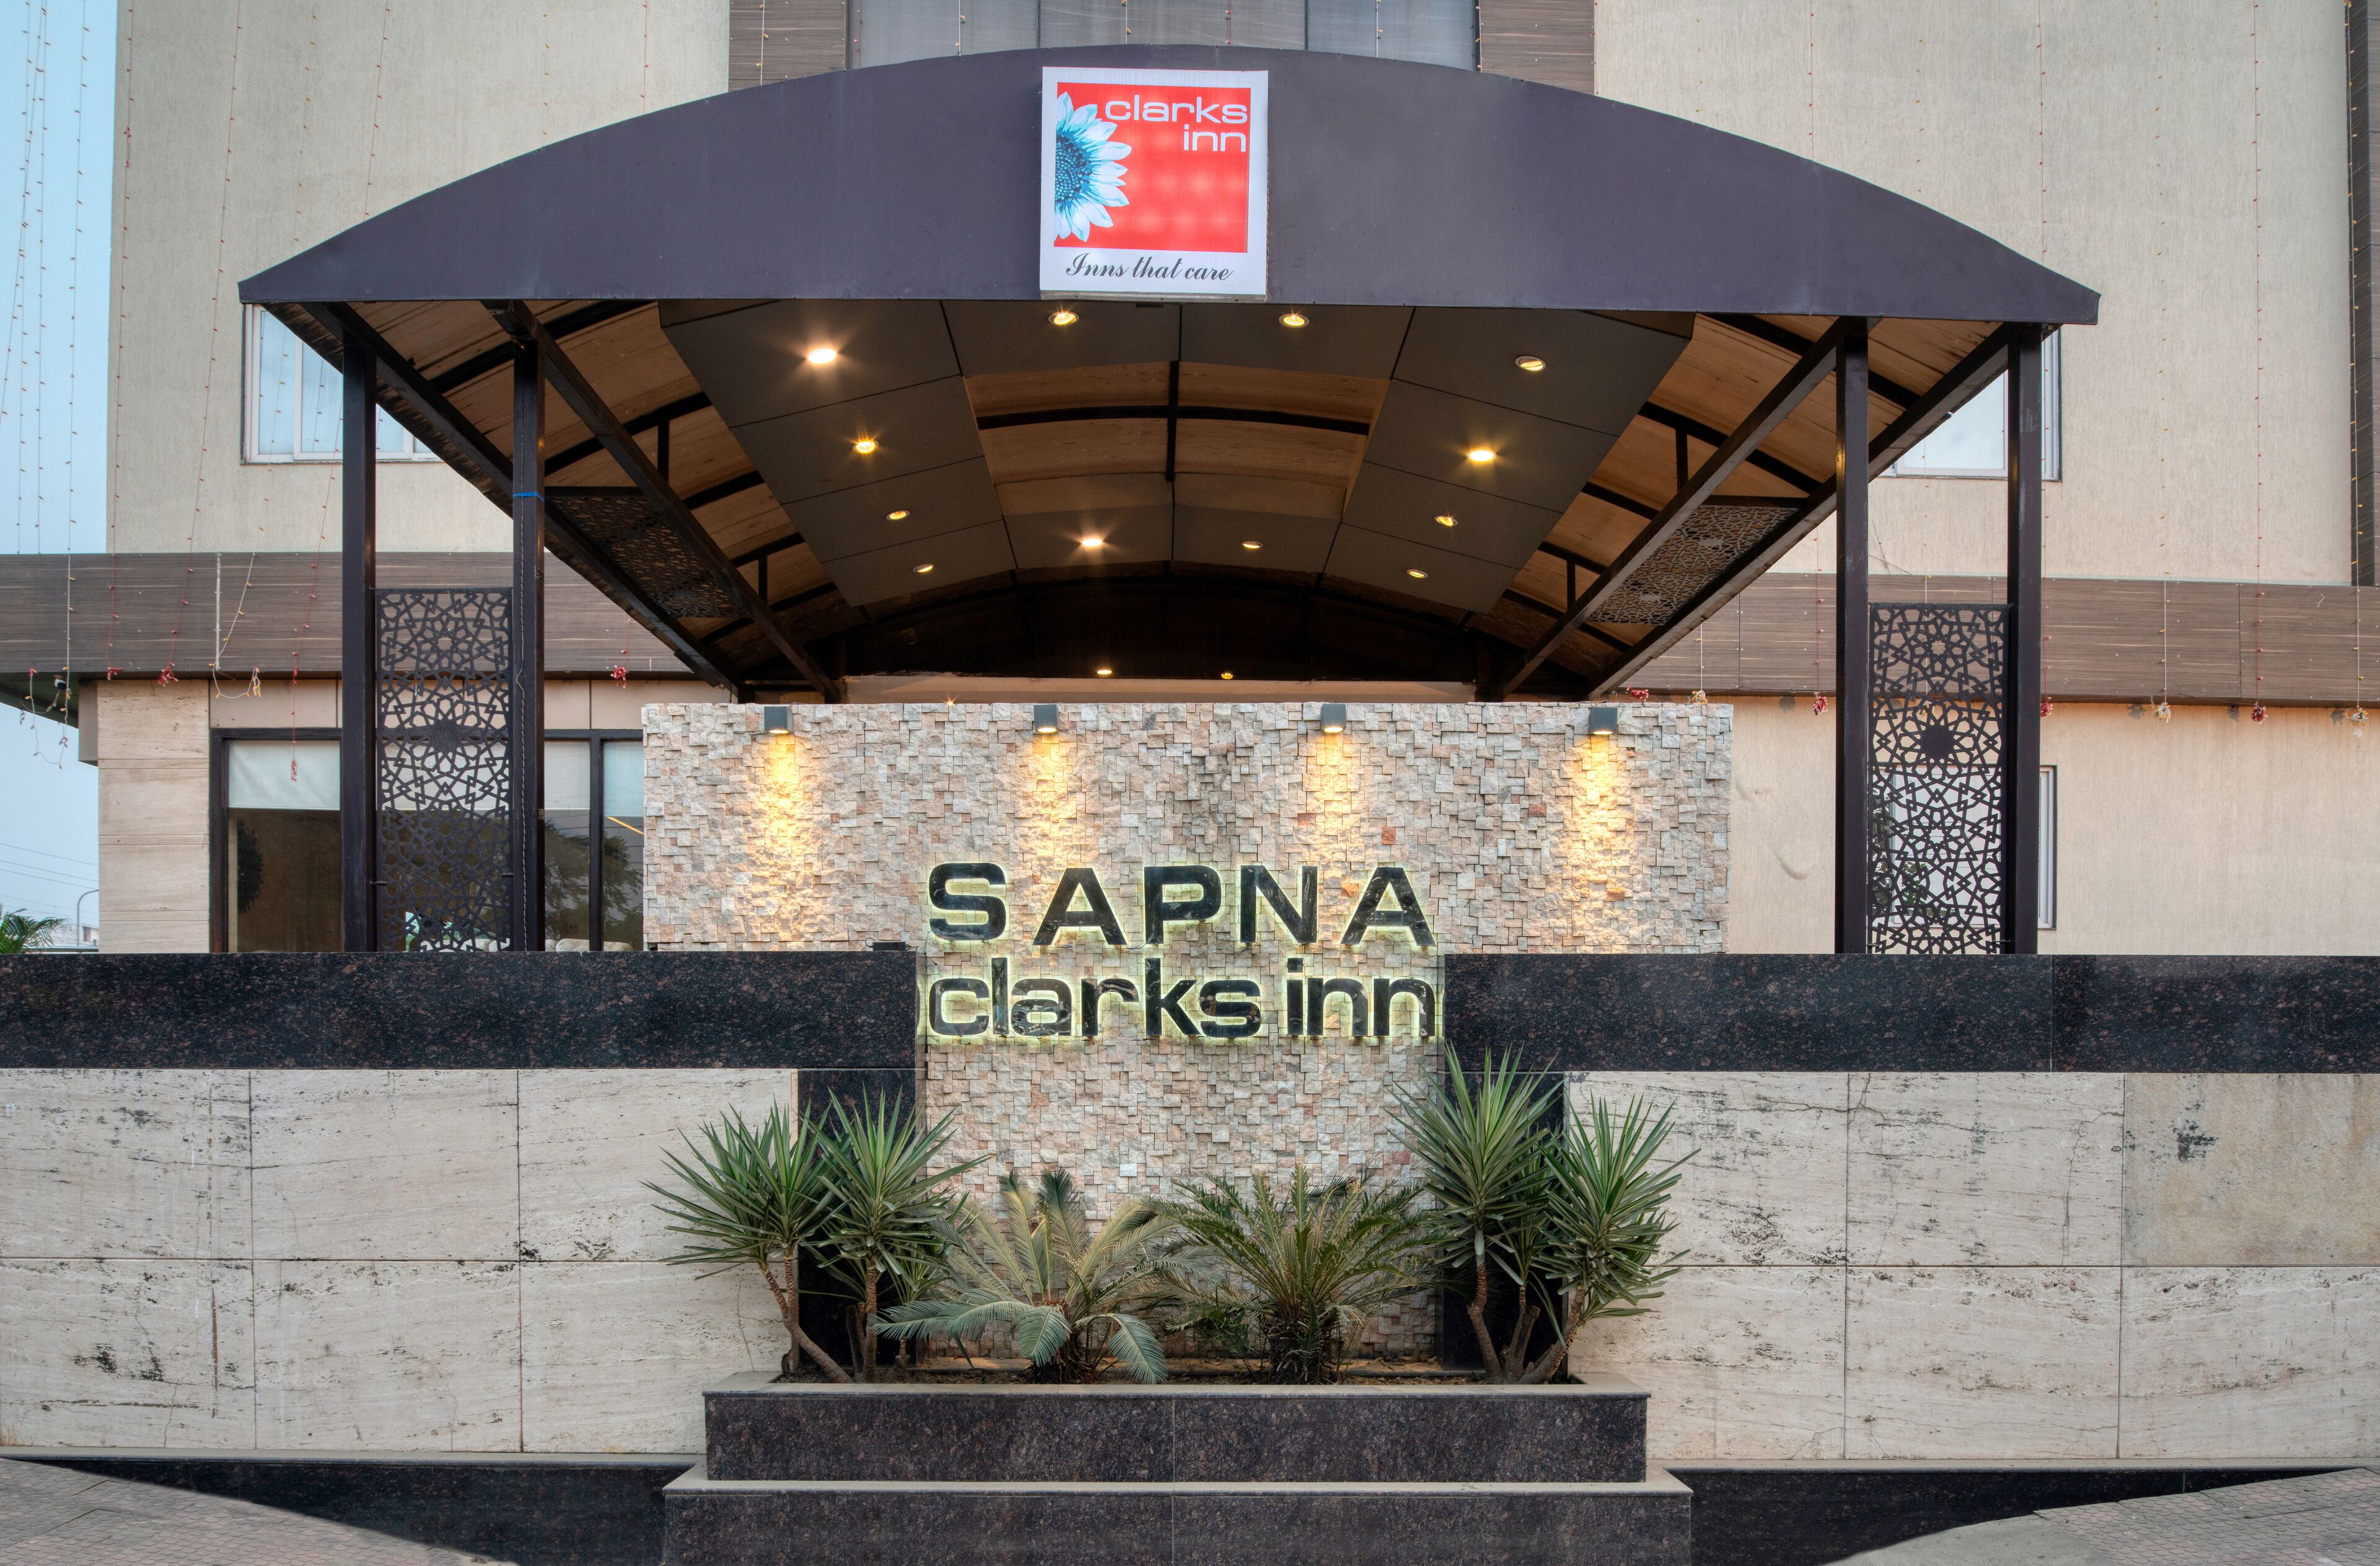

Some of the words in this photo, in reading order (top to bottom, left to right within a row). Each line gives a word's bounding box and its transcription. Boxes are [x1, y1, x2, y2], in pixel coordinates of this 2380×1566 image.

[1105, 94, 1248, 124] clarks
[1183, 124, 1246, 152] inn
[1066, 252, 1130, 278] Inns
[1132, 256, 1183, 279] that
[1184, 267, 1235, 281] care
[928, 862, 1436, 947] SAPNA
[928, 957, 1261, 1038] clarks
[1287, 957, 1435, 1038] inn
